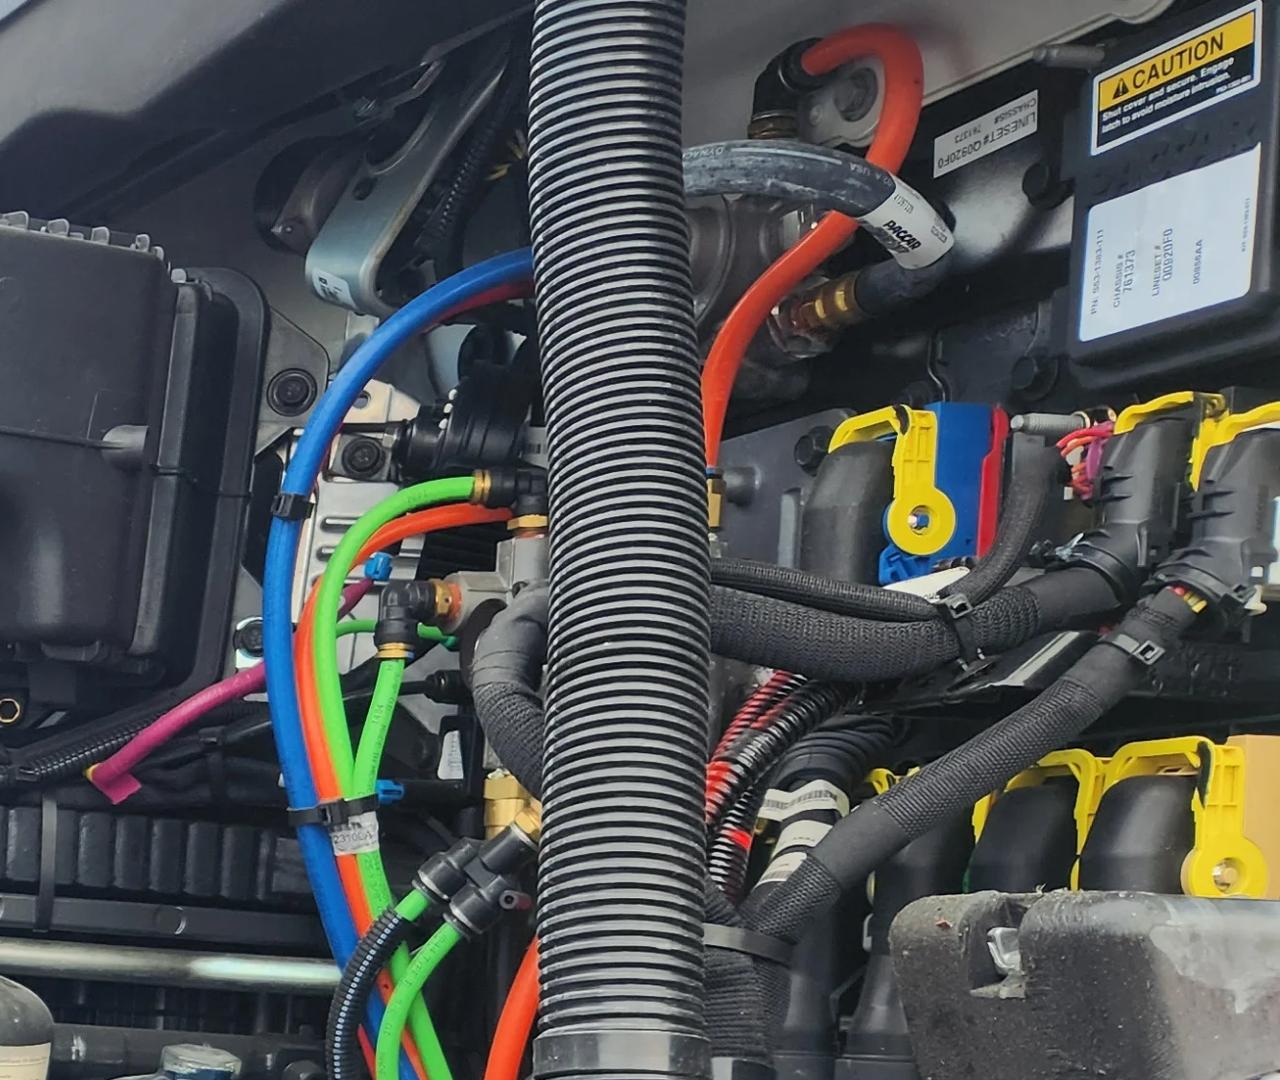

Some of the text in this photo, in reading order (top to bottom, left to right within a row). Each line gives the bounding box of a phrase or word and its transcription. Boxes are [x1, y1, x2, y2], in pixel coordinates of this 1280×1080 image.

[1132, 32, 1224, 89] CAUTION
[1102, 107, 1122, 122] Shut
[1123, 96, 1147, 112] cover
[1148, 87, 1165, 102] and
[1166, 74, 1198, 93] secure.
[1200, 57, 1235, 78] Engage
[1102, 119, 1121, 134] latch
[1131, 103, 1154, 121] avoid
[1154, 88, 1190, 111] moisture
[1191, 71, 1232, 95] intrusion.
[882, 218, 922, 251] PACCAR
[1123, 250, 1136, 293] 761373
[1151, 253, 1162, 297] LINESET
